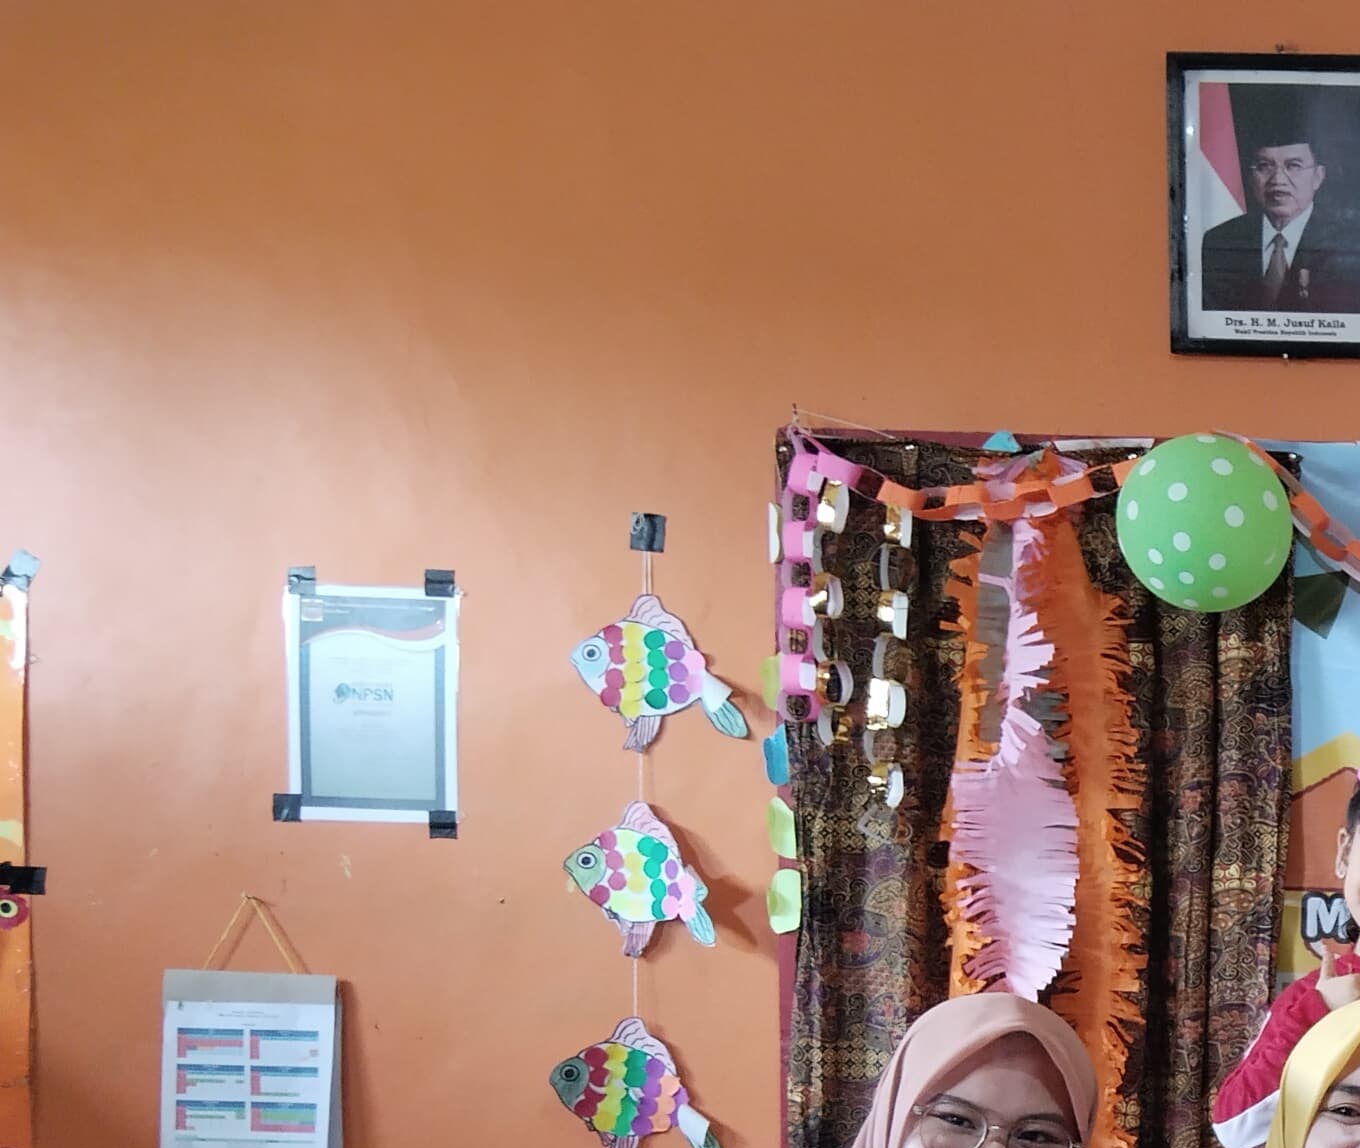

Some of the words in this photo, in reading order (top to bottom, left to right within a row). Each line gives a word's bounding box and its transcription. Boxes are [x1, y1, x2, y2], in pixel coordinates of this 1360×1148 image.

[1225, 316, 1247, 327] Drs.
[1251, 316, 1264, 327] H.
[1267, 317, 1281, 328] M.
[1284, 317, 1315, 328] Jusuf
[352, 687, 394, 702] NPSN
